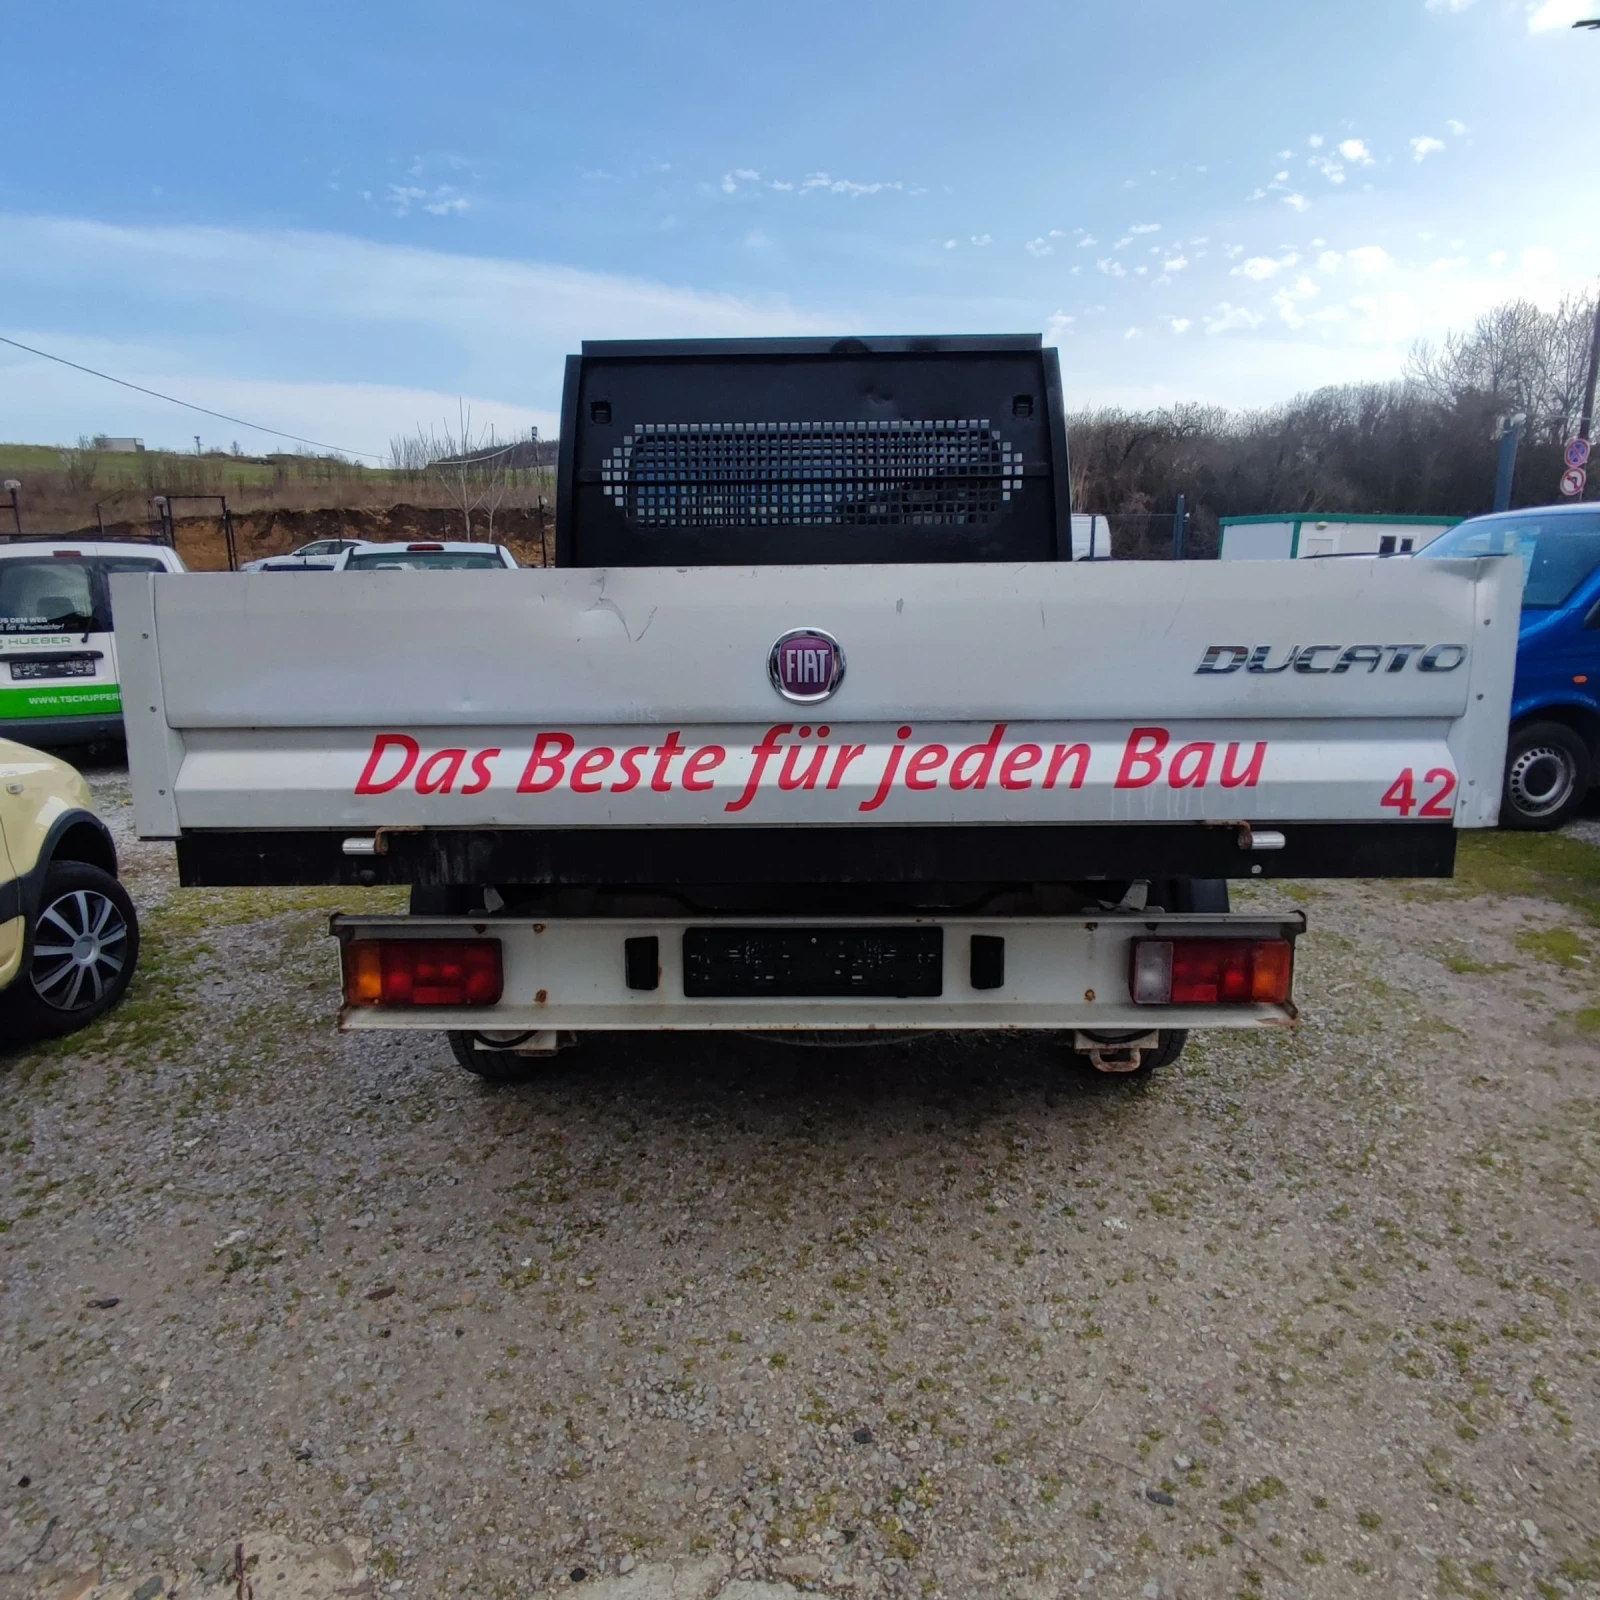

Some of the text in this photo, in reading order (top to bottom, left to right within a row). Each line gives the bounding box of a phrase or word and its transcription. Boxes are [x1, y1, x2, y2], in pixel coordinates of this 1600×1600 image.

[8, 636, 71, 645] HUEBER
[786, 649, 829, 683] FIAT
[1194, 644, 1468, 674] DUCATO
[355, 724, 1267, 813] Das Beste für jeden Bau
[1381, 768, 1457, 819] 42
